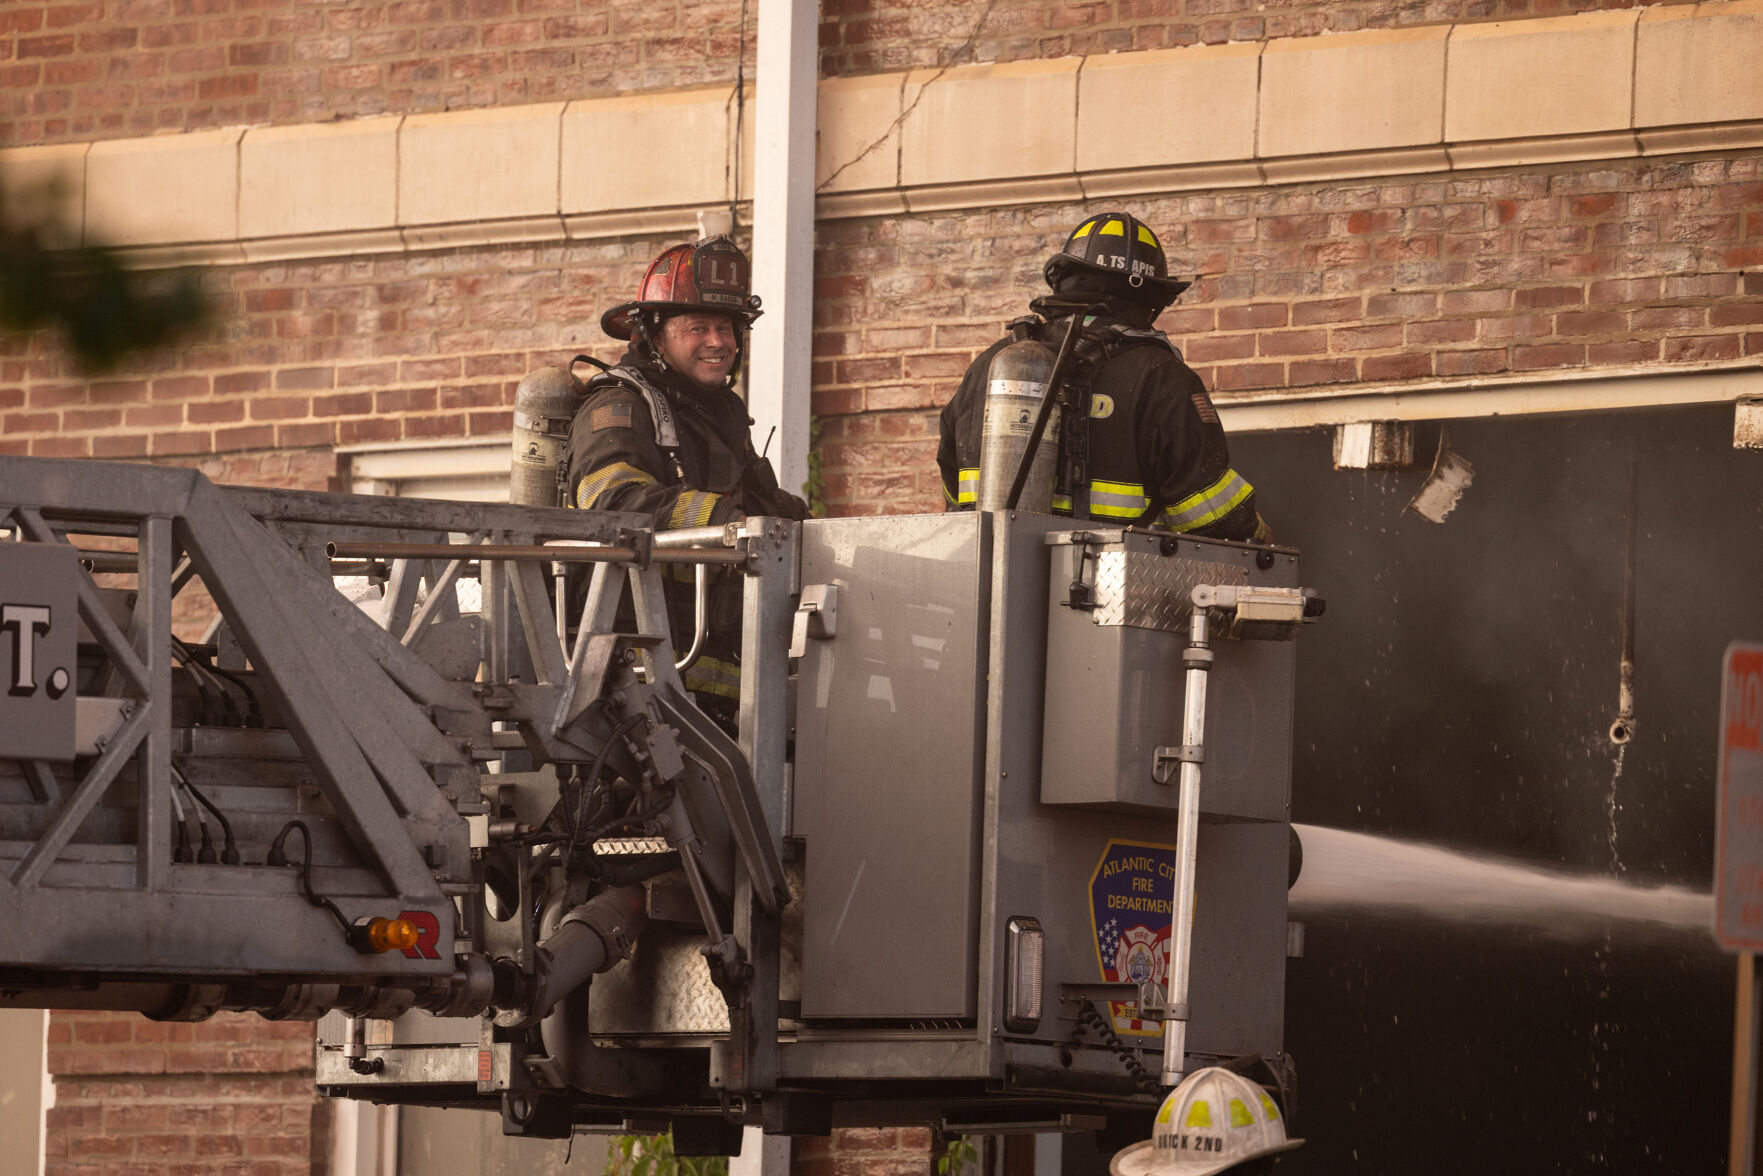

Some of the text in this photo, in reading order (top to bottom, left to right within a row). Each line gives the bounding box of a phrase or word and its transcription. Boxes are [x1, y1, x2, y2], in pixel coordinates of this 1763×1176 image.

[1103, 857, 1176, 881] ATLANTIC CIT
[1132, 877, 1154, 893] FIRE
[1195, 1135, 1223, 1152] 2ND
